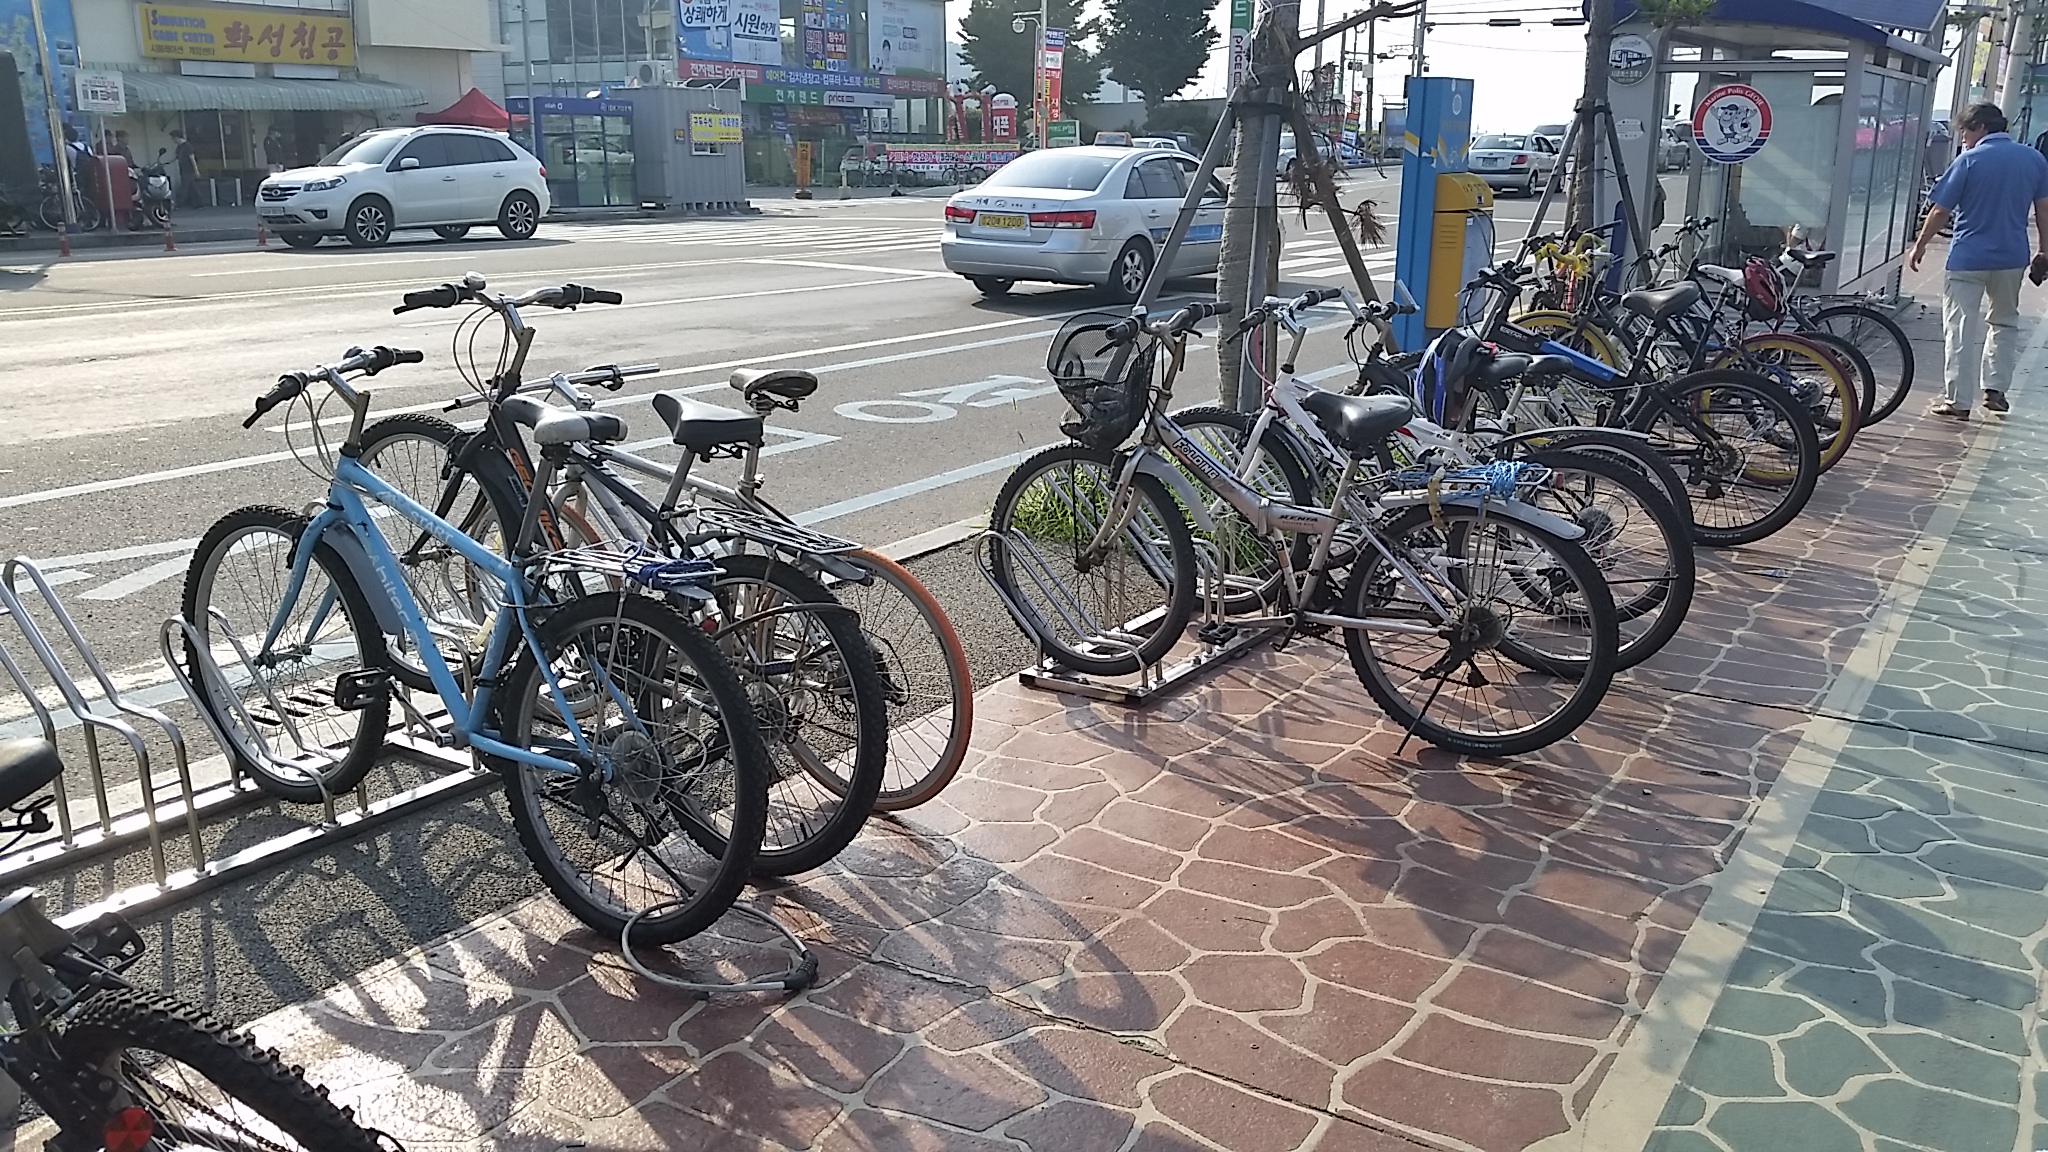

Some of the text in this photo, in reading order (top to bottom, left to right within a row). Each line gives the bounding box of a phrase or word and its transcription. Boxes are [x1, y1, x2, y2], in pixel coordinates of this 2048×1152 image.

[684, 5, 728, 24] 상쾌하게
[734, 12, 777, 36] 시원하게
[152, 29, 215, 44] GAME CENTER
[223, 20, 346, 60] 화성침공
[1233, 35, 1246, 70] price
[690, 63, 724, 78] 전자랜드
[724, 65, 746, 79] price
[775, 89, 846, 105] 전자랜드 price
[1704, 91, 1727, 107] Marine
[1727, 87, 1744, 95] Polis
[1003, 217, 1022, 228] 1200
[1172, 437, 1220, 480] FOLDING
[410, 511, 454, 543] START
